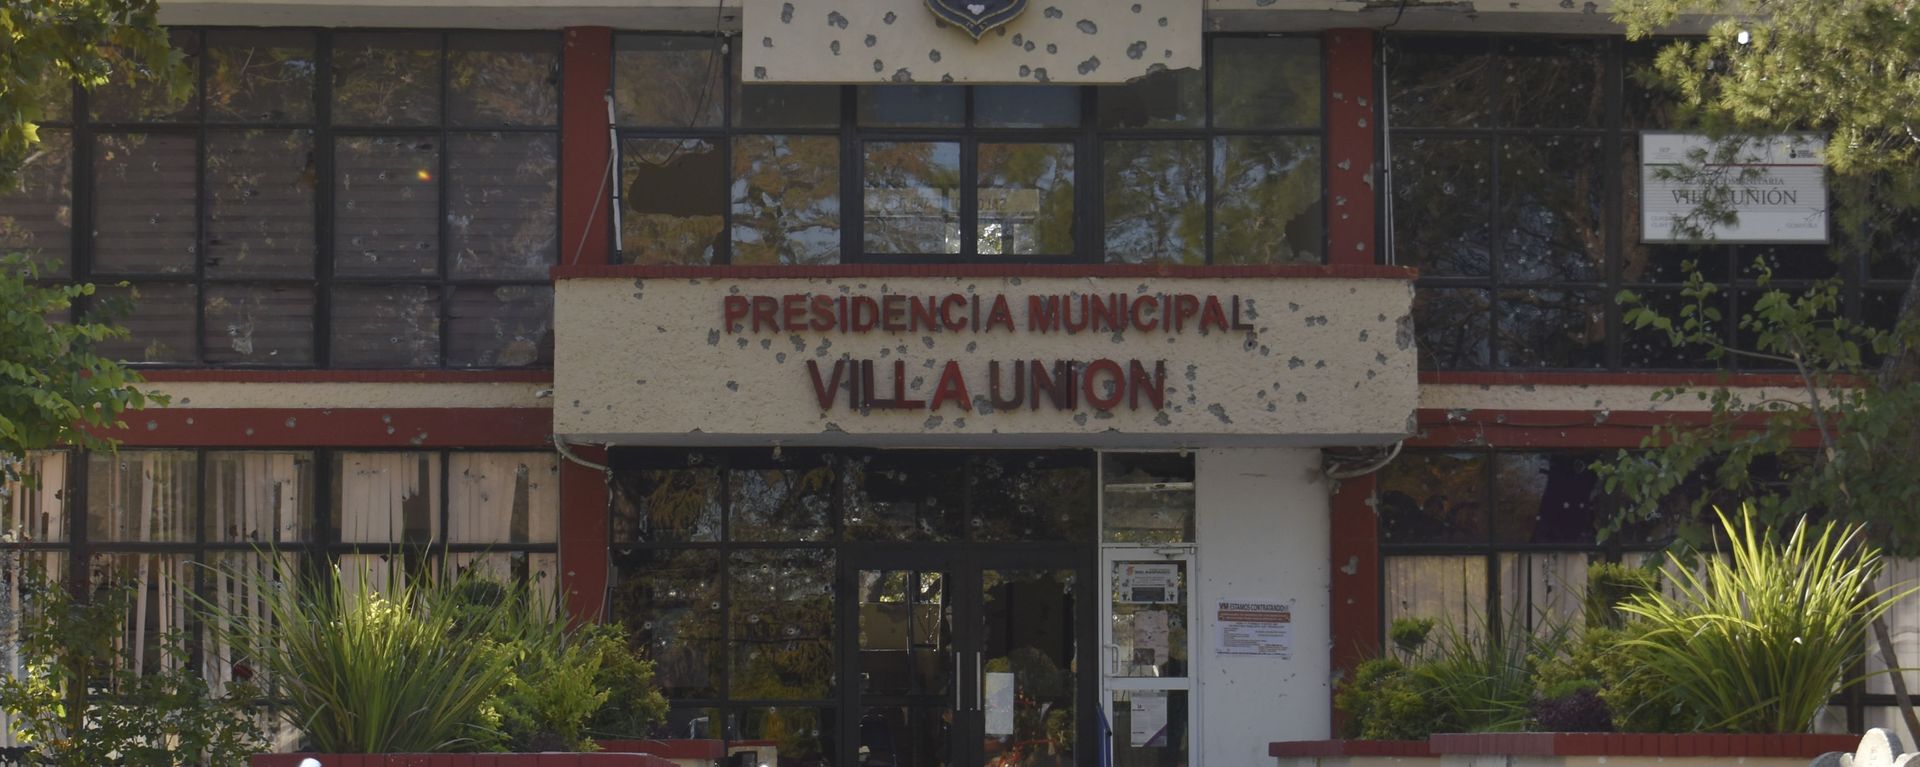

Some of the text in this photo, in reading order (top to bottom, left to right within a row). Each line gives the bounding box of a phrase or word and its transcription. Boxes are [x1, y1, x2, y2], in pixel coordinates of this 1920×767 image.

[1731, 187, 1797, 205] UNIÓN
[724, 293, 1254, 332] PRESIDENCIA MUNICIPAL
[807, 358, 1165, 411] VILLA UNION
